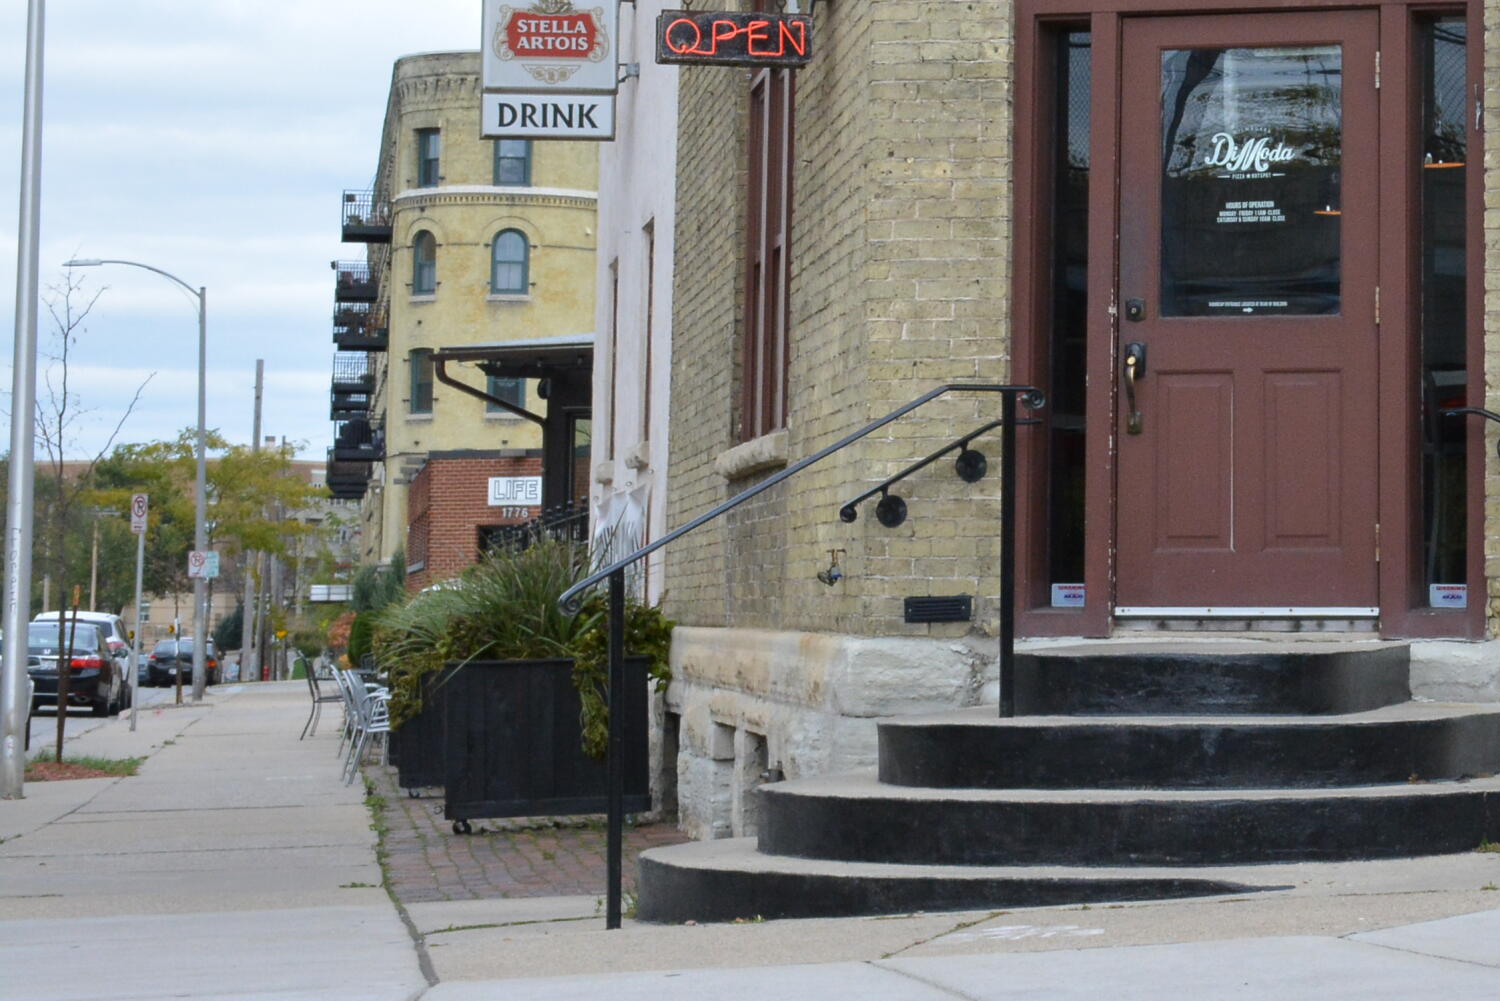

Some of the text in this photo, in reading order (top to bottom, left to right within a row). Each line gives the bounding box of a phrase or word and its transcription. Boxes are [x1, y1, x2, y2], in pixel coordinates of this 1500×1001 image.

[517, 19, 588, 34] STELLA
[517, 36, 589, 51] ARTOIS
[665, 18, 806, 57] OPEN
[497, 102, 600, 130] DRINK
[493, 479, 539, 500] LIFE
[502, 507, 528, 518] 1776
